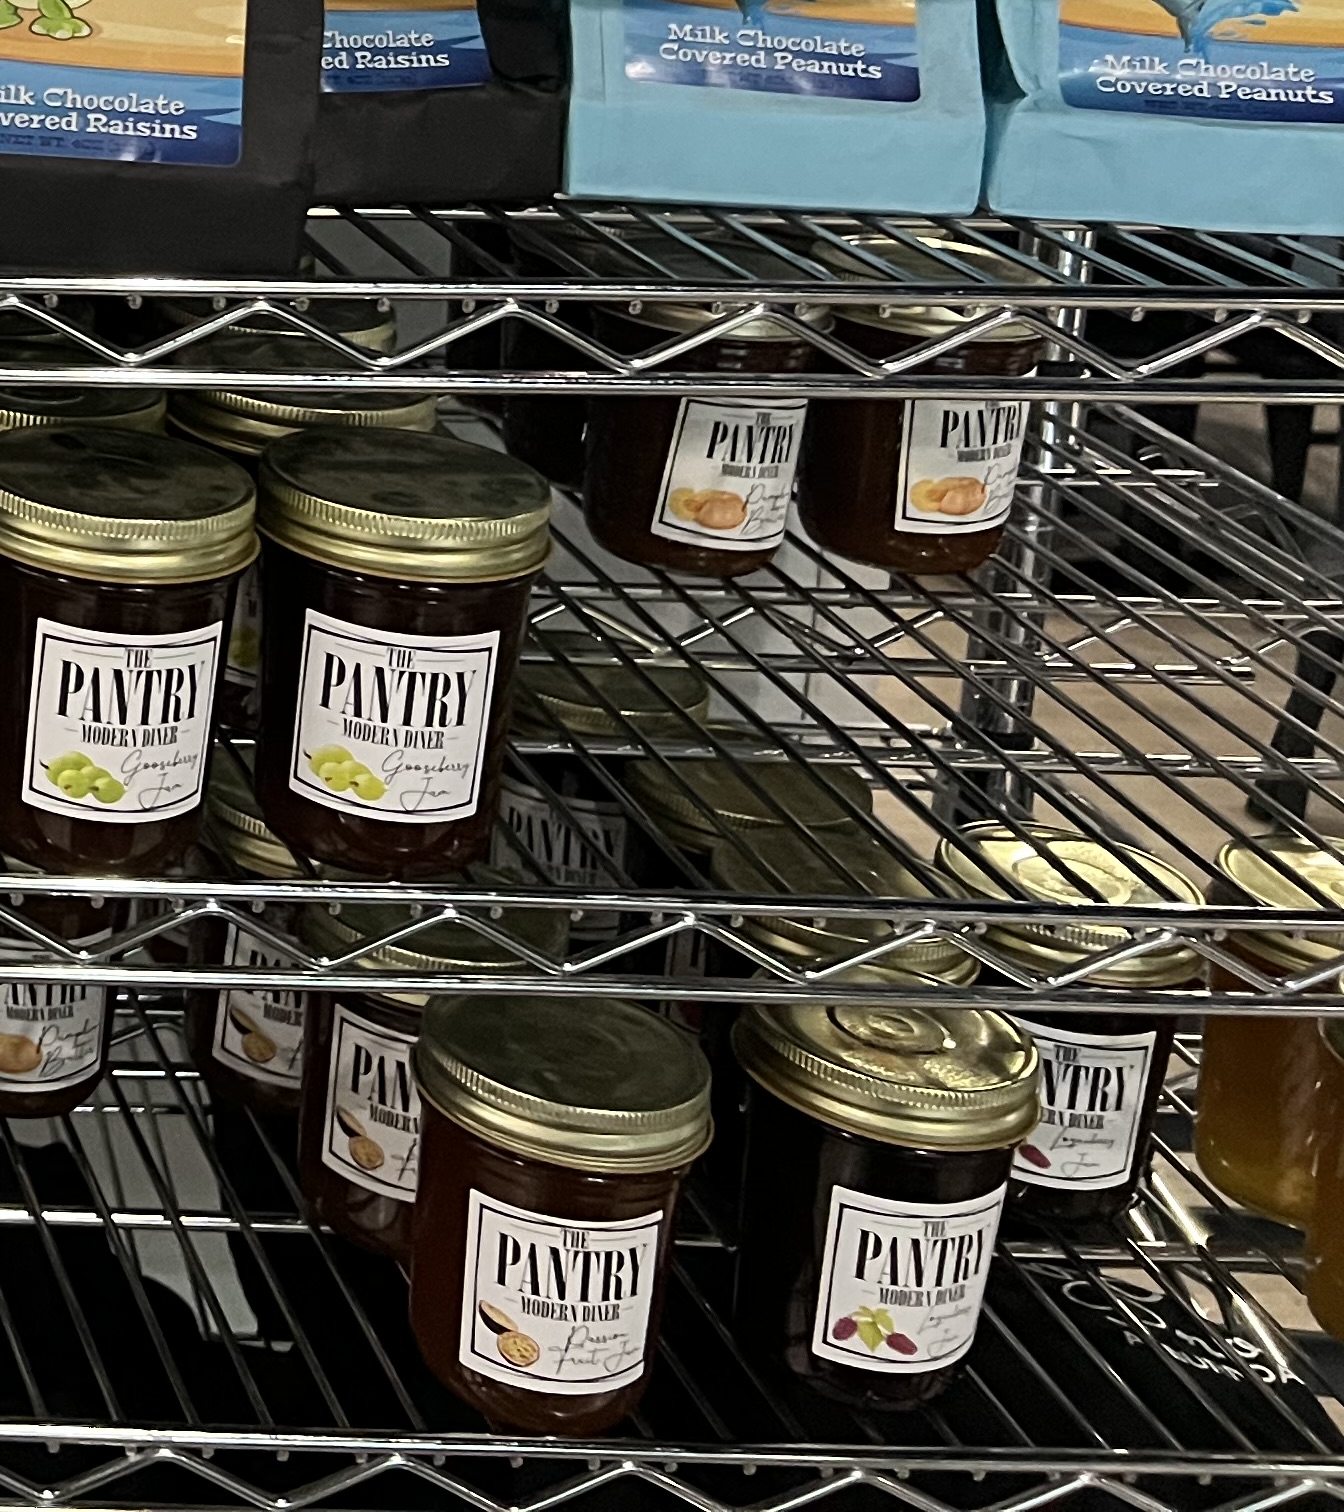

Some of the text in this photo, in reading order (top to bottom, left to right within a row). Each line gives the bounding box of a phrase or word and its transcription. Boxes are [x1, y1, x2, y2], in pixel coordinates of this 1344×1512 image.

[354, 51, 451, 70] Raisins
[658, 41, 883, 80] Covered Peanuts
[1103, 54, 1316, 84] Milk Chocolate
[1095, 75, 1335, 105] Covered Peanuts
[85, 111, 199, 142] Raisins
[56, 658, 206, 726] PANTRY
[318, 650, 478, 729] PANTRY
[343, 717, 445, 750] MODERN DINER
[381, 749, 471, 786] Gooseberry
[494, 1231, 649, 1303] PANTRY
[854, 1222, 992, 1289] PANTRY
